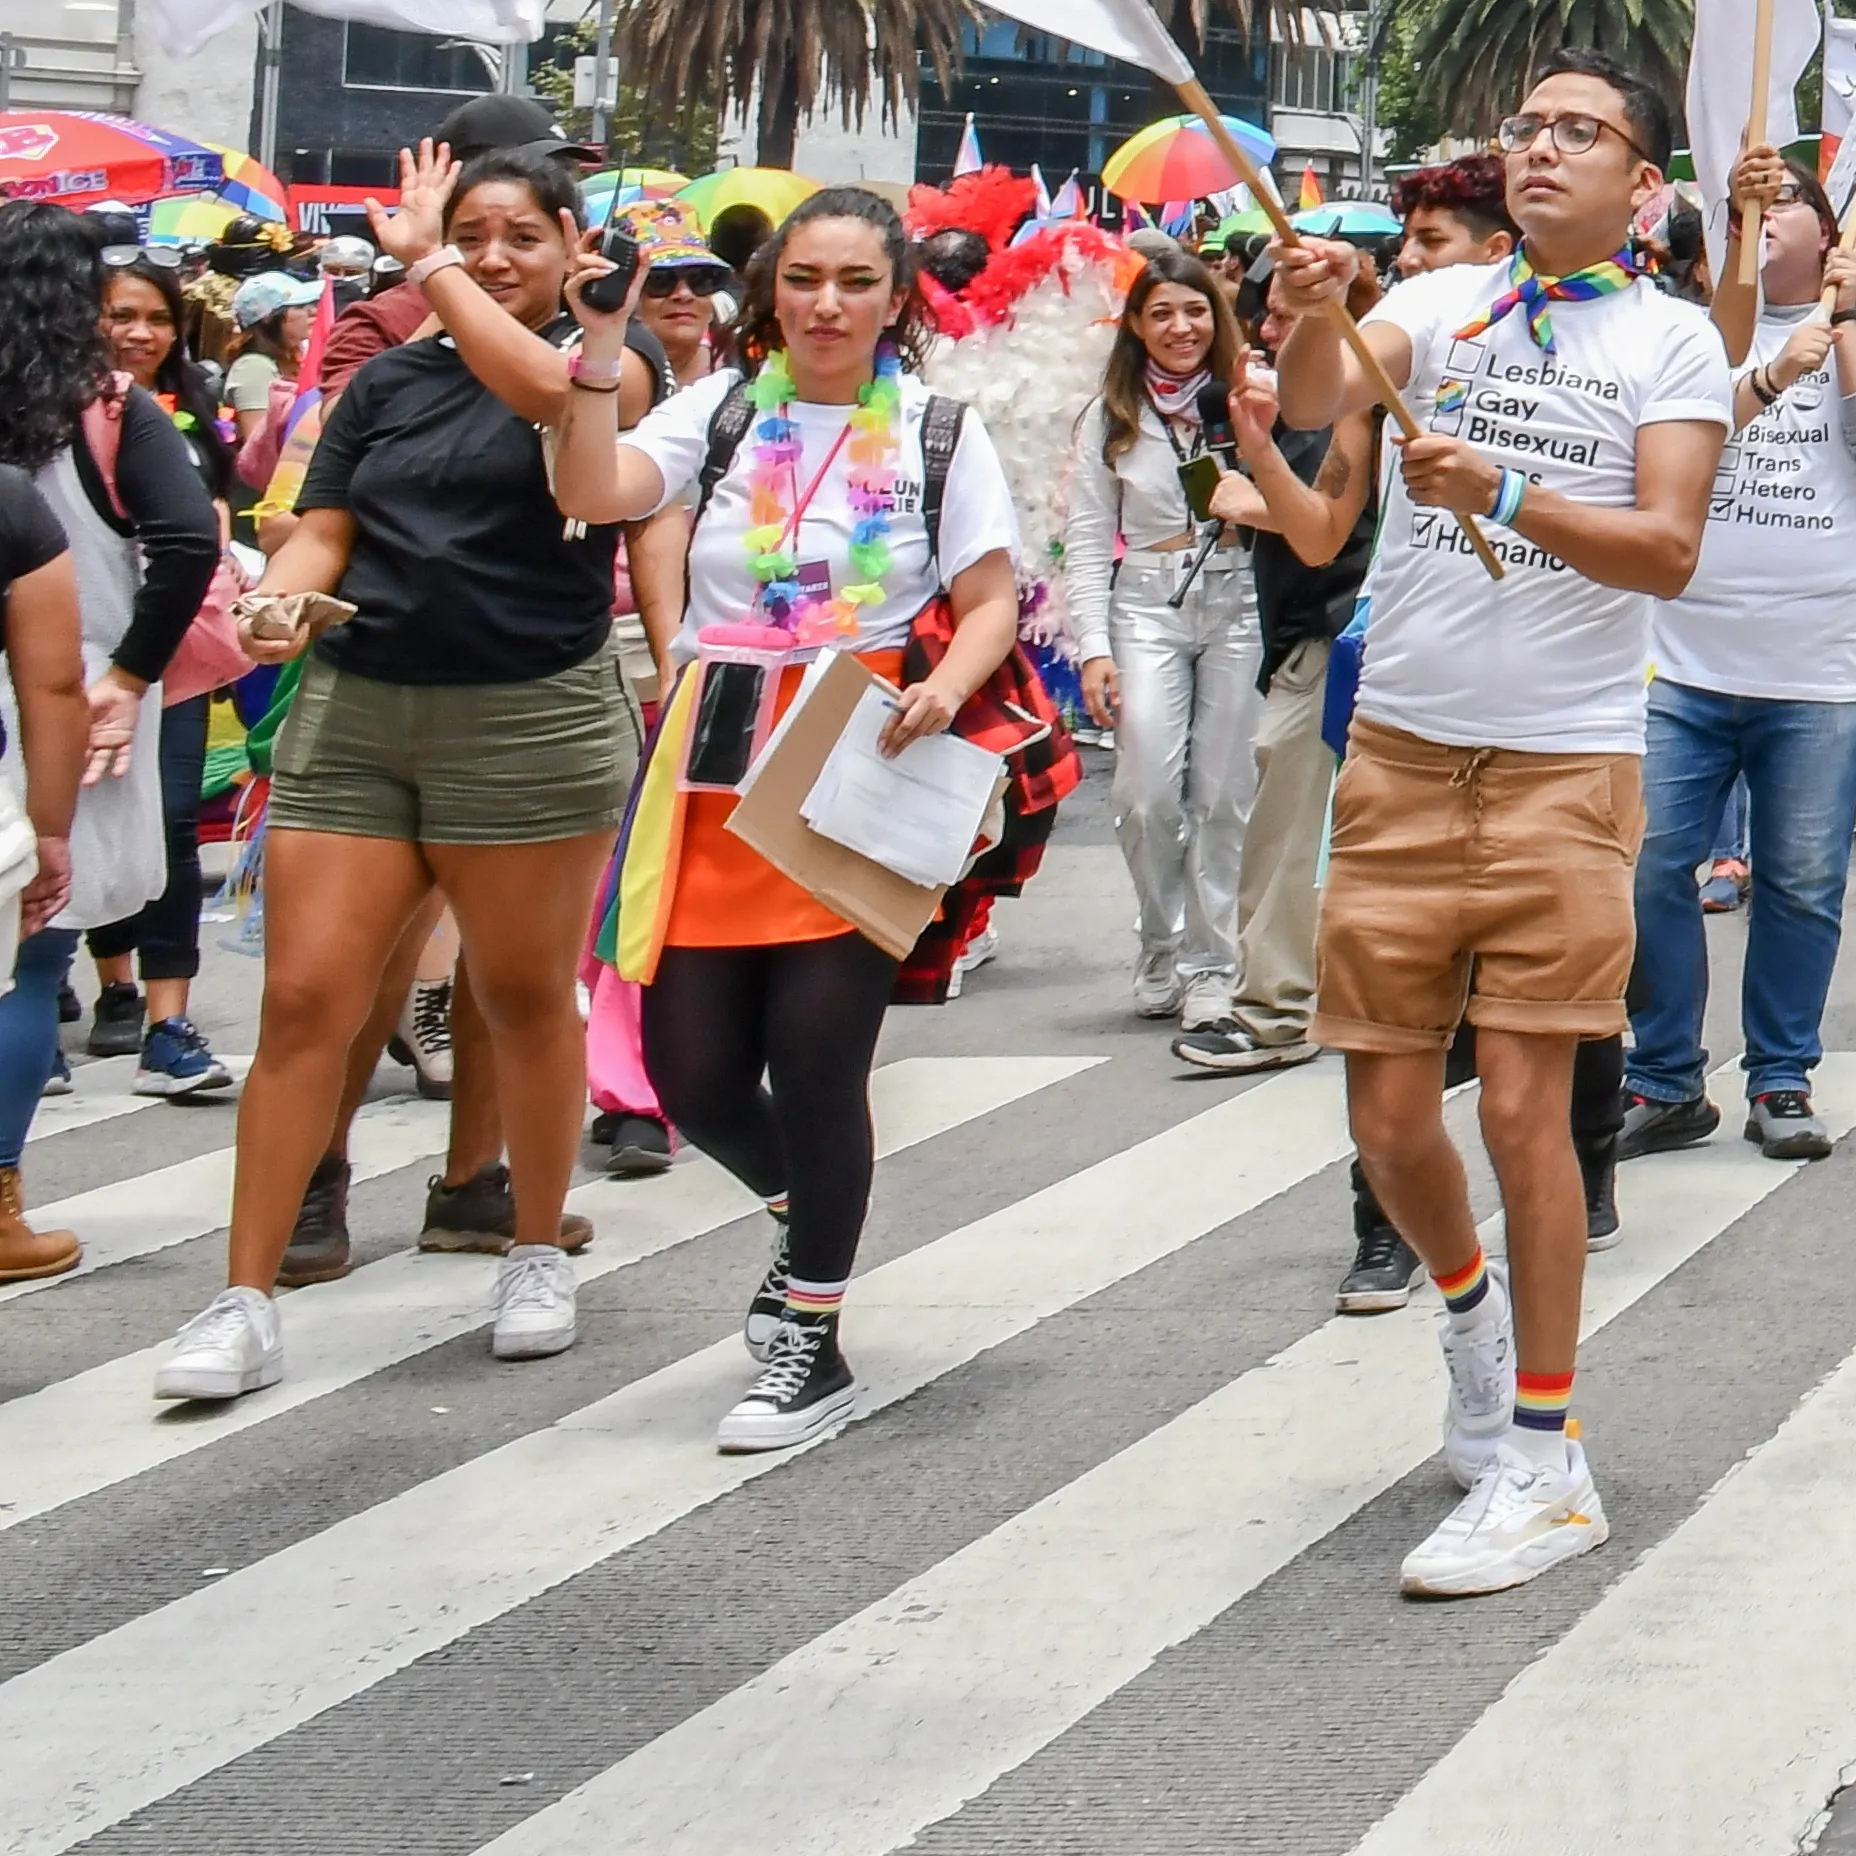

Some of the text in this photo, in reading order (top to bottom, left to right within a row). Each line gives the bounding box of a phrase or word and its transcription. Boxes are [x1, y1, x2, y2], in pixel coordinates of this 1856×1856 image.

[1486, 353, 1620, 401] Lesbiana
[1475, 390, 1540, 422] Gay
[1467, 416, 1600, 467] Bisexual
[1747, 422, 1830, 445] Bisexual
[1744, 451, 1802, 472] Trans
[1739, 479, 1817, 502] Hetero
[1736, 504, 1835, 530] Humano
